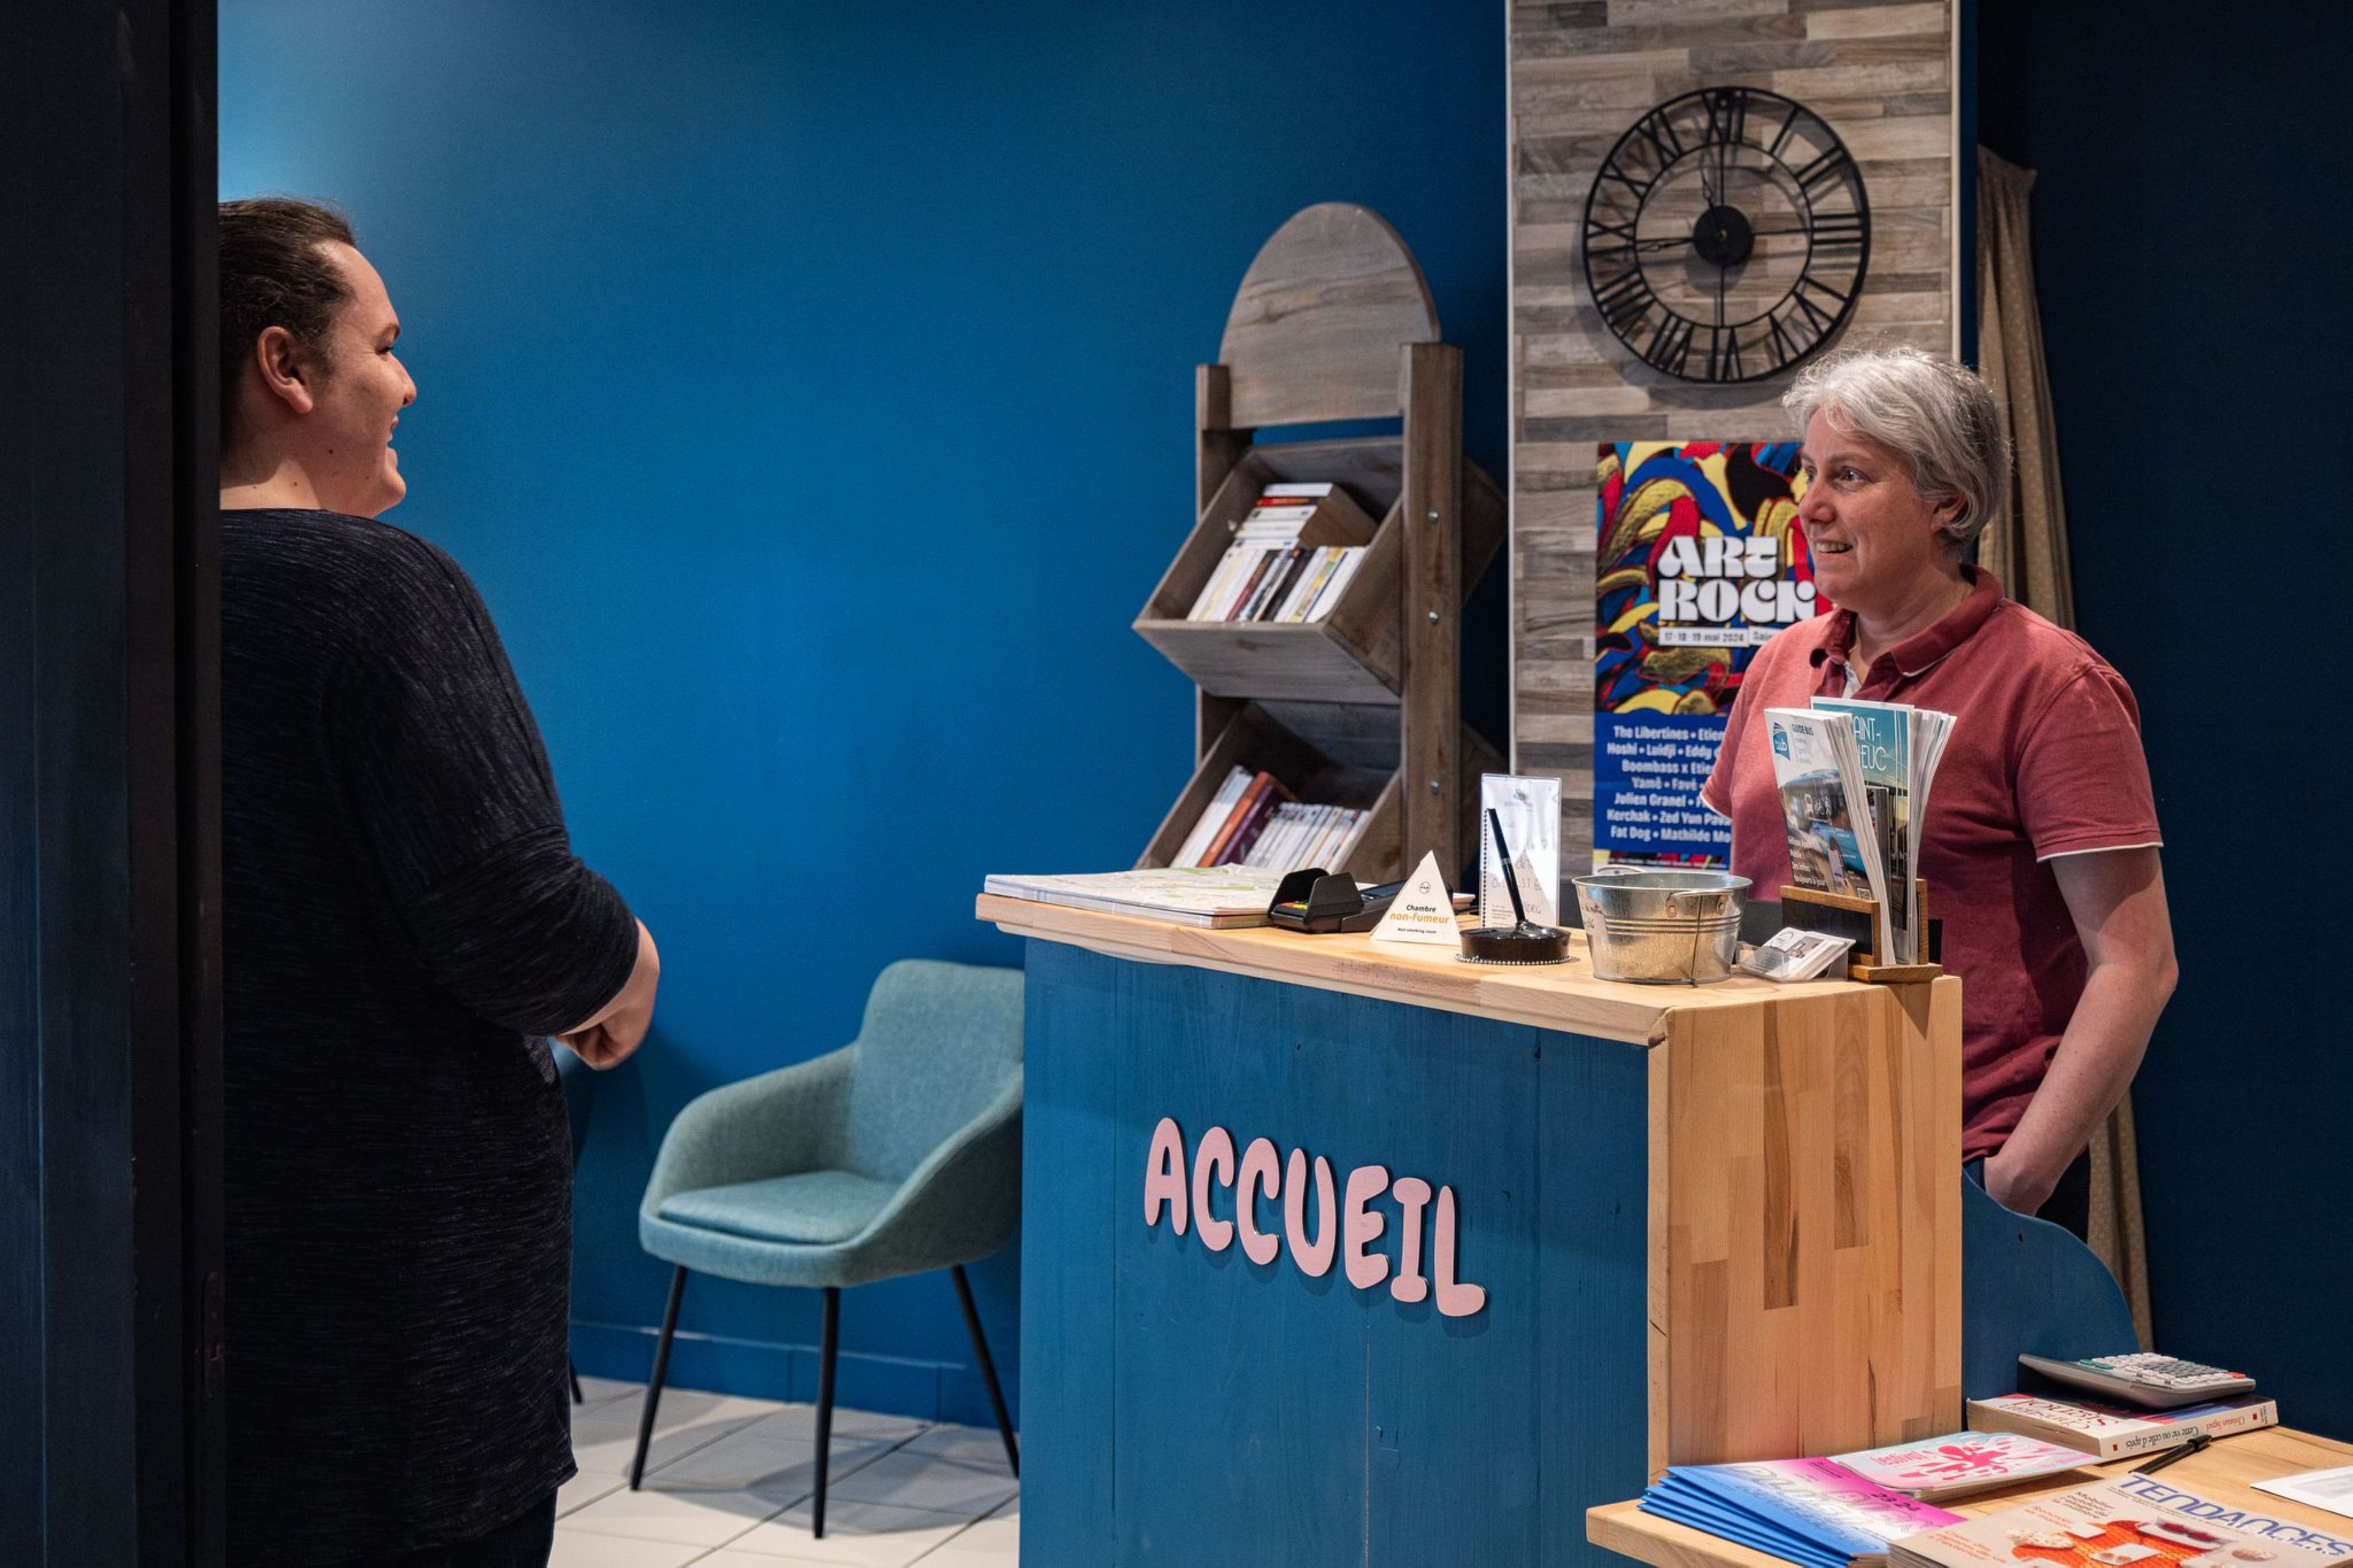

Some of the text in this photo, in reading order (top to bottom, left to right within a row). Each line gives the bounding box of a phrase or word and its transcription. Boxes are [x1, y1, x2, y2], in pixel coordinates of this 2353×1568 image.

[1658, 536, 1777, 577] ART
[1658, 580, 1816, 623] ROCK
[1722, 634, 1745, 643] 2024
[1613, 725, 1633, 738] The
[1635, 726, 1689, 741] Libertines
[1853, 715, 1881, 742] AINT-
[1607, 743, 1637, 755] Hoshi
[1685, 744, 1712, 760] Eddy
[1622, 759, 1679, 774] Boombass
[1681, 763, 1689, 774] x
[1614, 792, 1647, 806] Julien
[1649, 793, 1686, 808] Granel
[1607, 809, 1651, 823] Kerchak
[1659, 811, 1680, 824] Zed
[1610, 825, 1627, 839] Fat
[1629, 826, 1651, 842] Dog
[1661, 828, 1711, 843] Mathilde
[1406, 904, 1436, 913] Chambre
[1390, 912, 1449, 924] non-fumeur
[1144, 1117, 1485, 1317] ACCUEIL
[2181, 1425, 2200, 1437] Cette
[2120, 1474, 2353, 1556] TENDANCES
